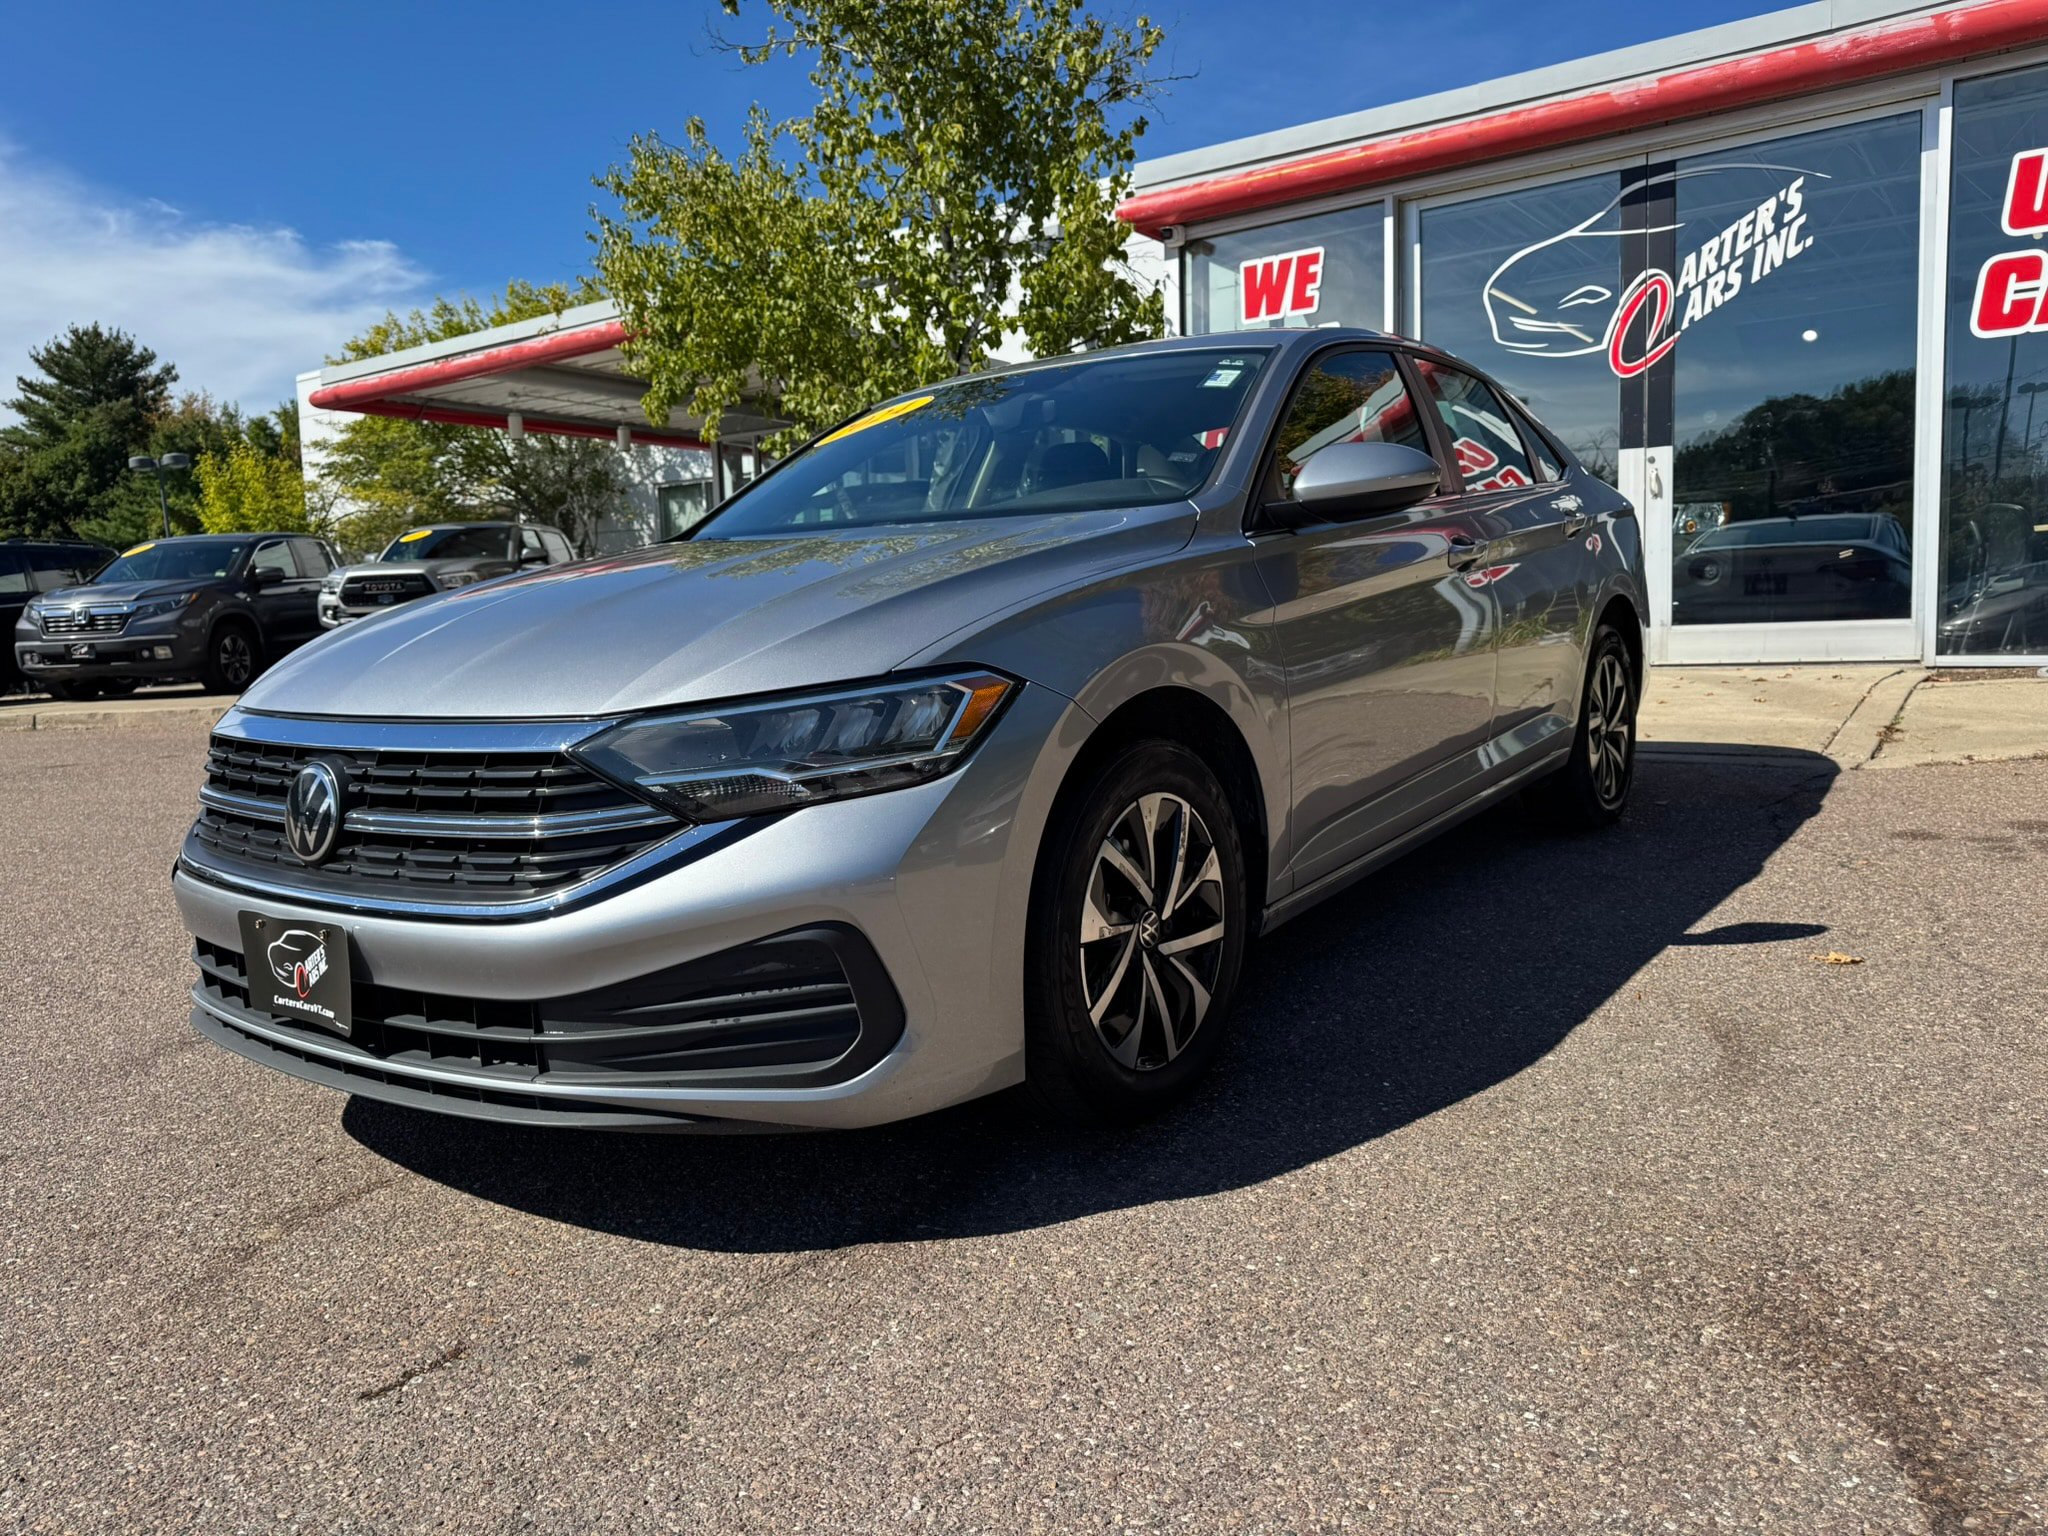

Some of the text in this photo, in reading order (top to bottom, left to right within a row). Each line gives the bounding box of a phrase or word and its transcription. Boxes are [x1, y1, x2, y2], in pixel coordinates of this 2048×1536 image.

[1751, 213, 1814, 284] INC.
[1241, 247, 1324, 324] WE
[364, 582, 403, 592] TOYOTA
